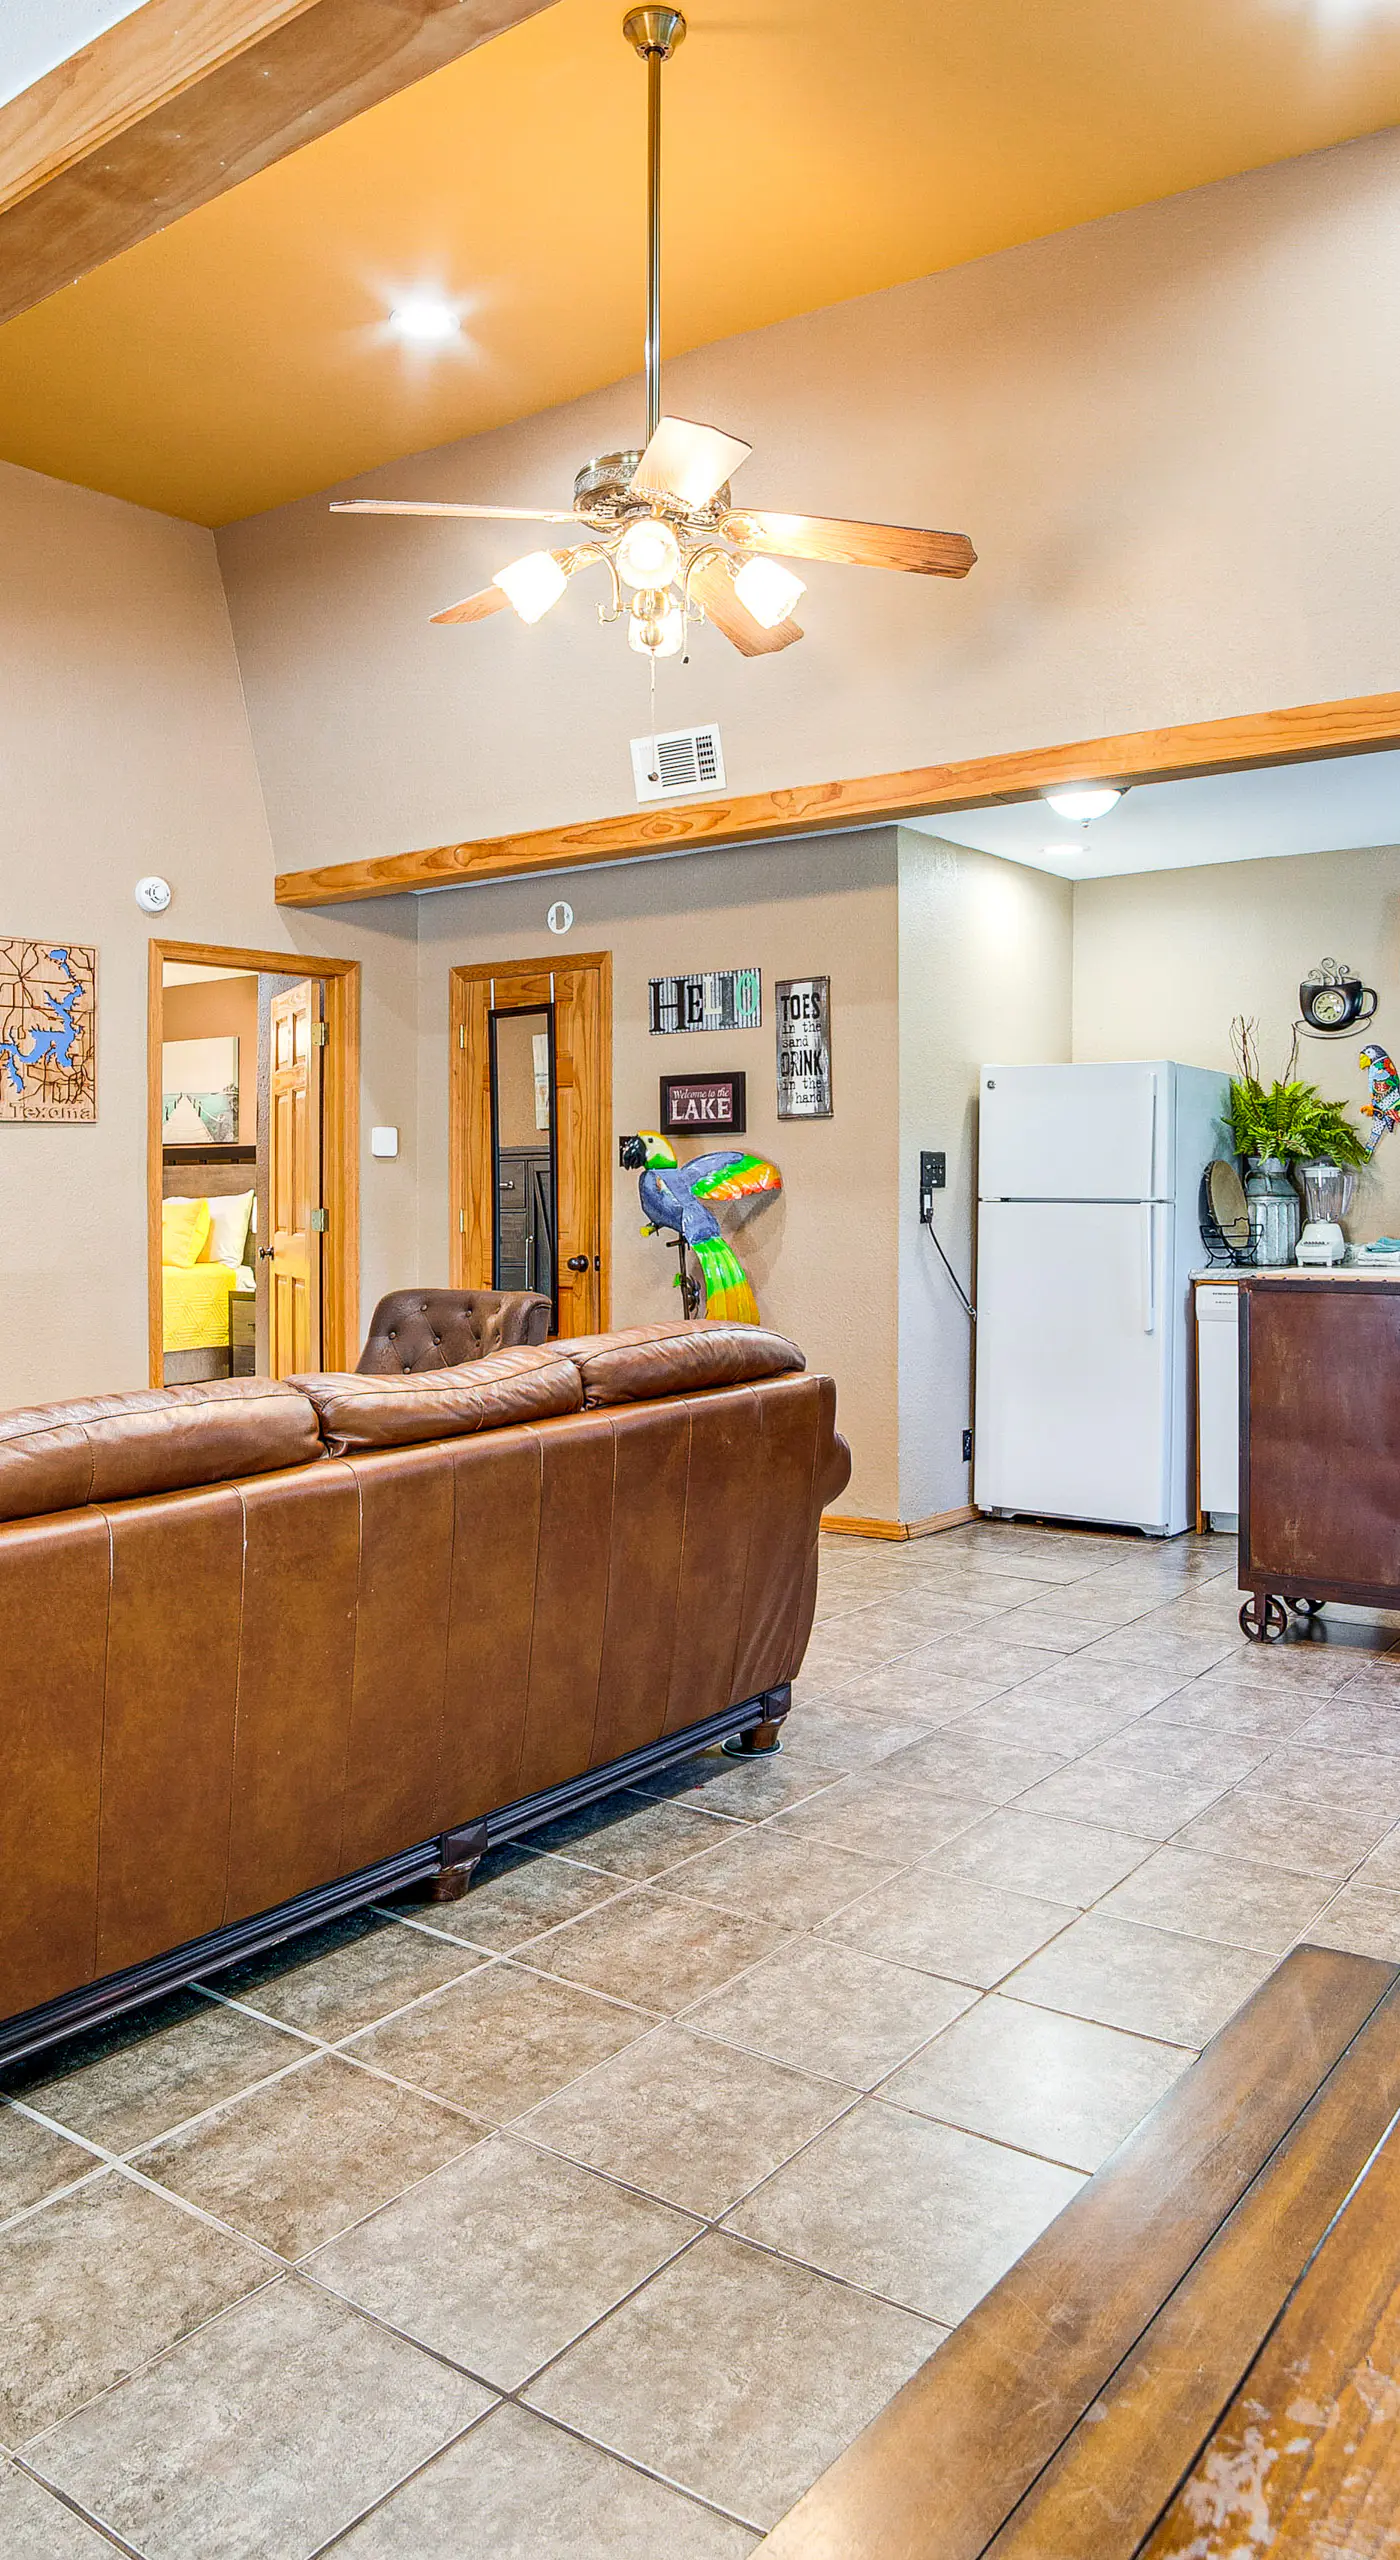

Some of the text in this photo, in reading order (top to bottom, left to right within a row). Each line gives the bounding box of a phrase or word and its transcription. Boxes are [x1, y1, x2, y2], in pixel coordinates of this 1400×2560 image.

[648, 972, 759, 1033] HELLO
[780, 992, 821, 1021] TOES
[782, 1020, 822, 1035] in the
[782, 1034, 809, 1048] sand
[781, 1049, 823, 1077] DRINK
[782, 1077, 822, 1091] in the
[673, 1087, 730, 1100] Welcome to the
[795, 1091, 823, 1104] hand
[9, 1102, 91, 1119] Texoma
[671, 1098, 732, 1121] LAKE
